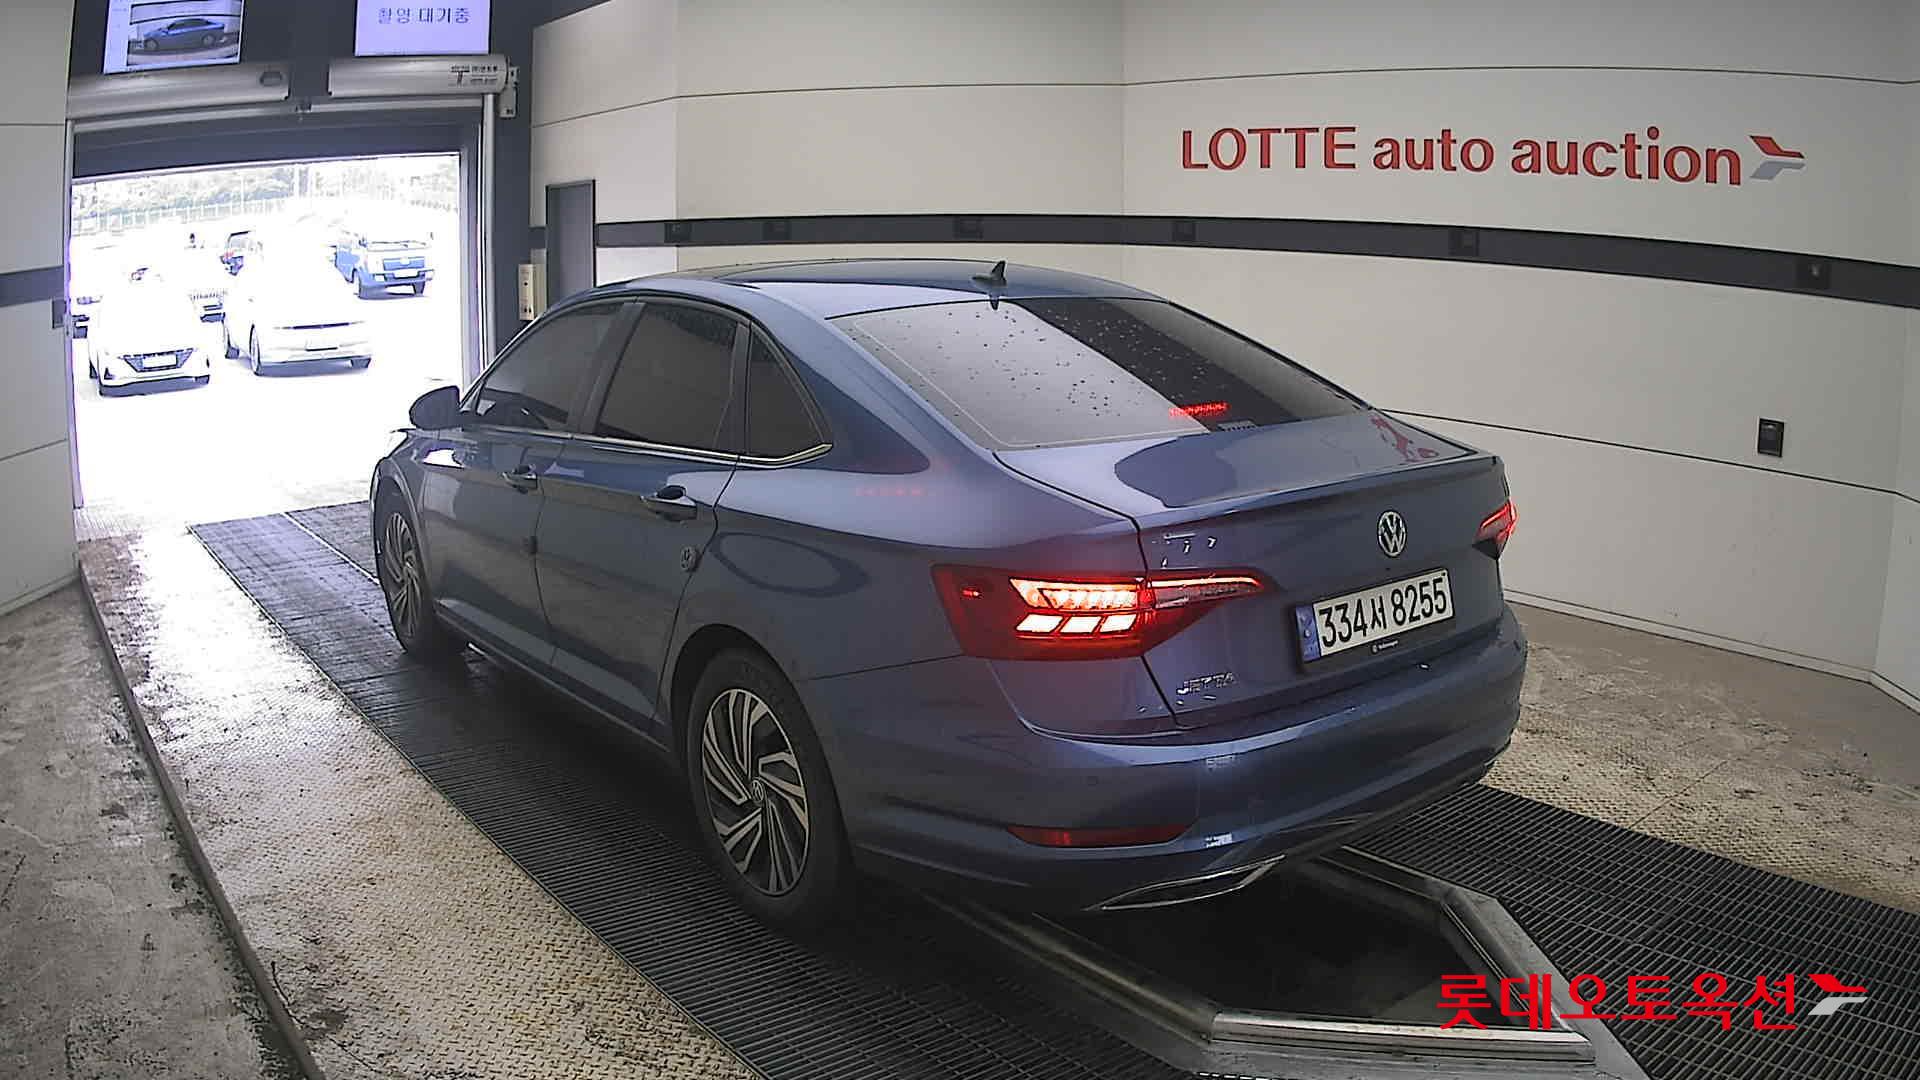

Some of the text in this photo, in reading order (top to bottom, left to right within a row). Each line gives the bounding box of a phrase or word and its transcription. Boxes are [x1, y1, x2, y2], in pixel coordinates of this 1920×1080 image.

[418, 7, 470, 24] 대기중
[1182, 126, 1742, 186] LOTTE auto auction
[1318, 577, 1447, 648] 334서 8255
